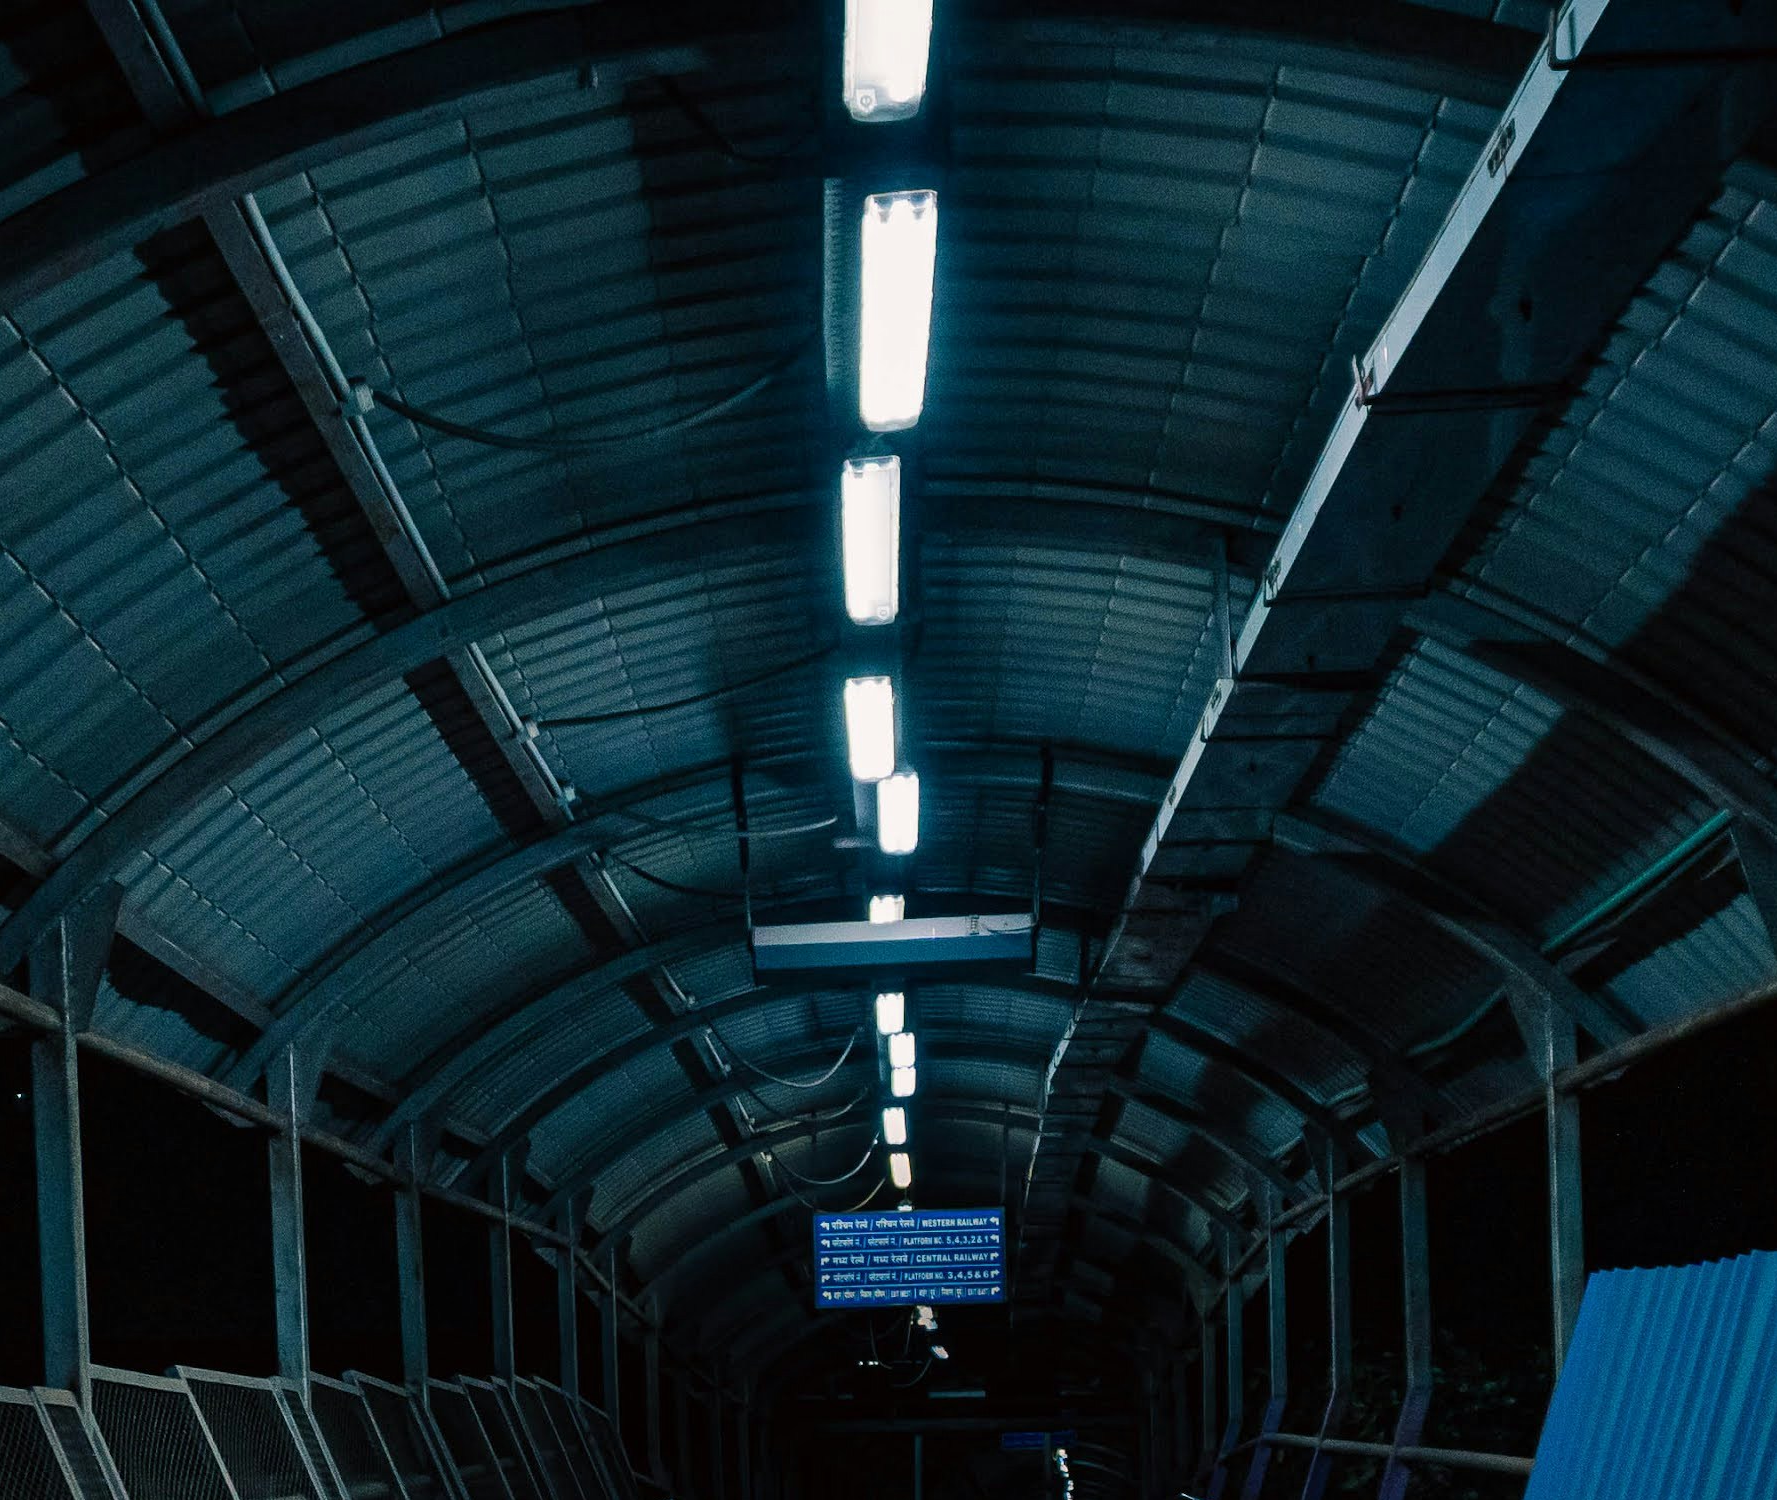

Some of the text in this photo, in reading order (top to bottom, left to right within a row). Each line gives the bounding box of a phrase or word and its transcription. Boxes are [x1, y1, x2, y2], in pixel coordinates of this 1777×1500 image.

[832, 1219, 853, 1230] पश्चिम
[876, 1219, 898, 1229] पश्चिम
[899, 1217, 914, 1227] रेलवे
[922, 1219, 955, 1227] WESTERN
[957, 1218, 987, 1226] RAILWAY
[904, 1237, 932, 1245] PLATFORM
[891, 1253, 908, 1263] रेलवे
[916, 1254, 951, 1262] CENTRAL
[904, 1272, 933, 1280] PLATFORM
